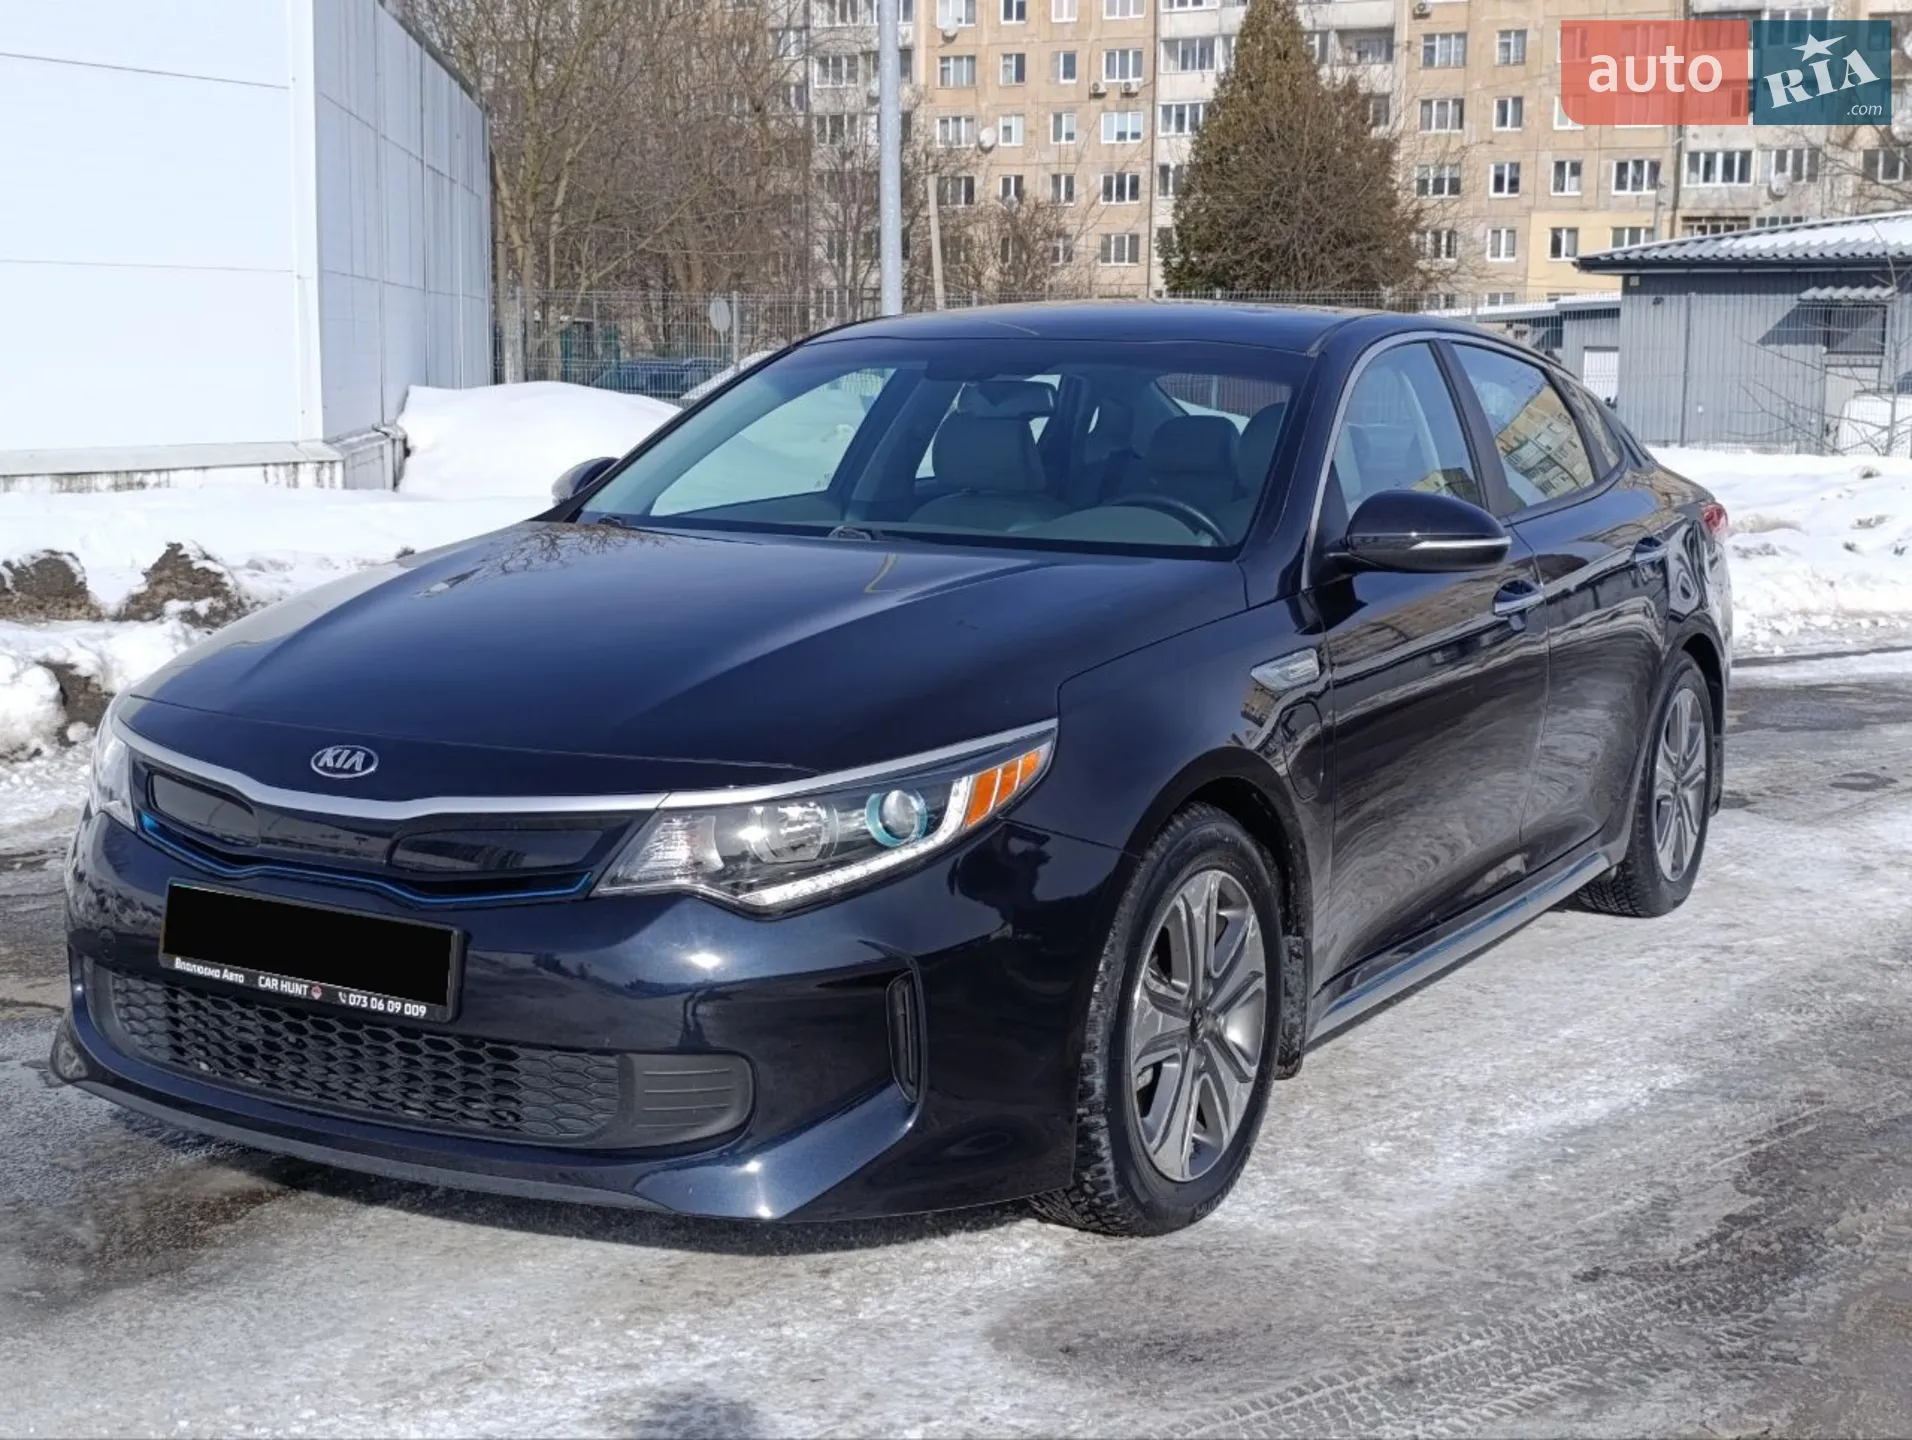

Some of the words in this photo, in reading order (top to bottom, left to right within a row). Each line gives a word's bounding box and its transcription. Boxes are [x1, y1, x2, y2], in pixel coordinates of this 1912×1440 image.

[317, 747, 366, 772] KIA
[222, 968, 245, 984] Авто
[258, 975, 279, 990] CAR
[280, 981, 309, 996] HUNT
[349, 993, 368, 1008] 073
[370, 997, 385, 1011] 06
[387, 1000, 402, 1013] 09
[404, 1002, 427, 1017] 009
